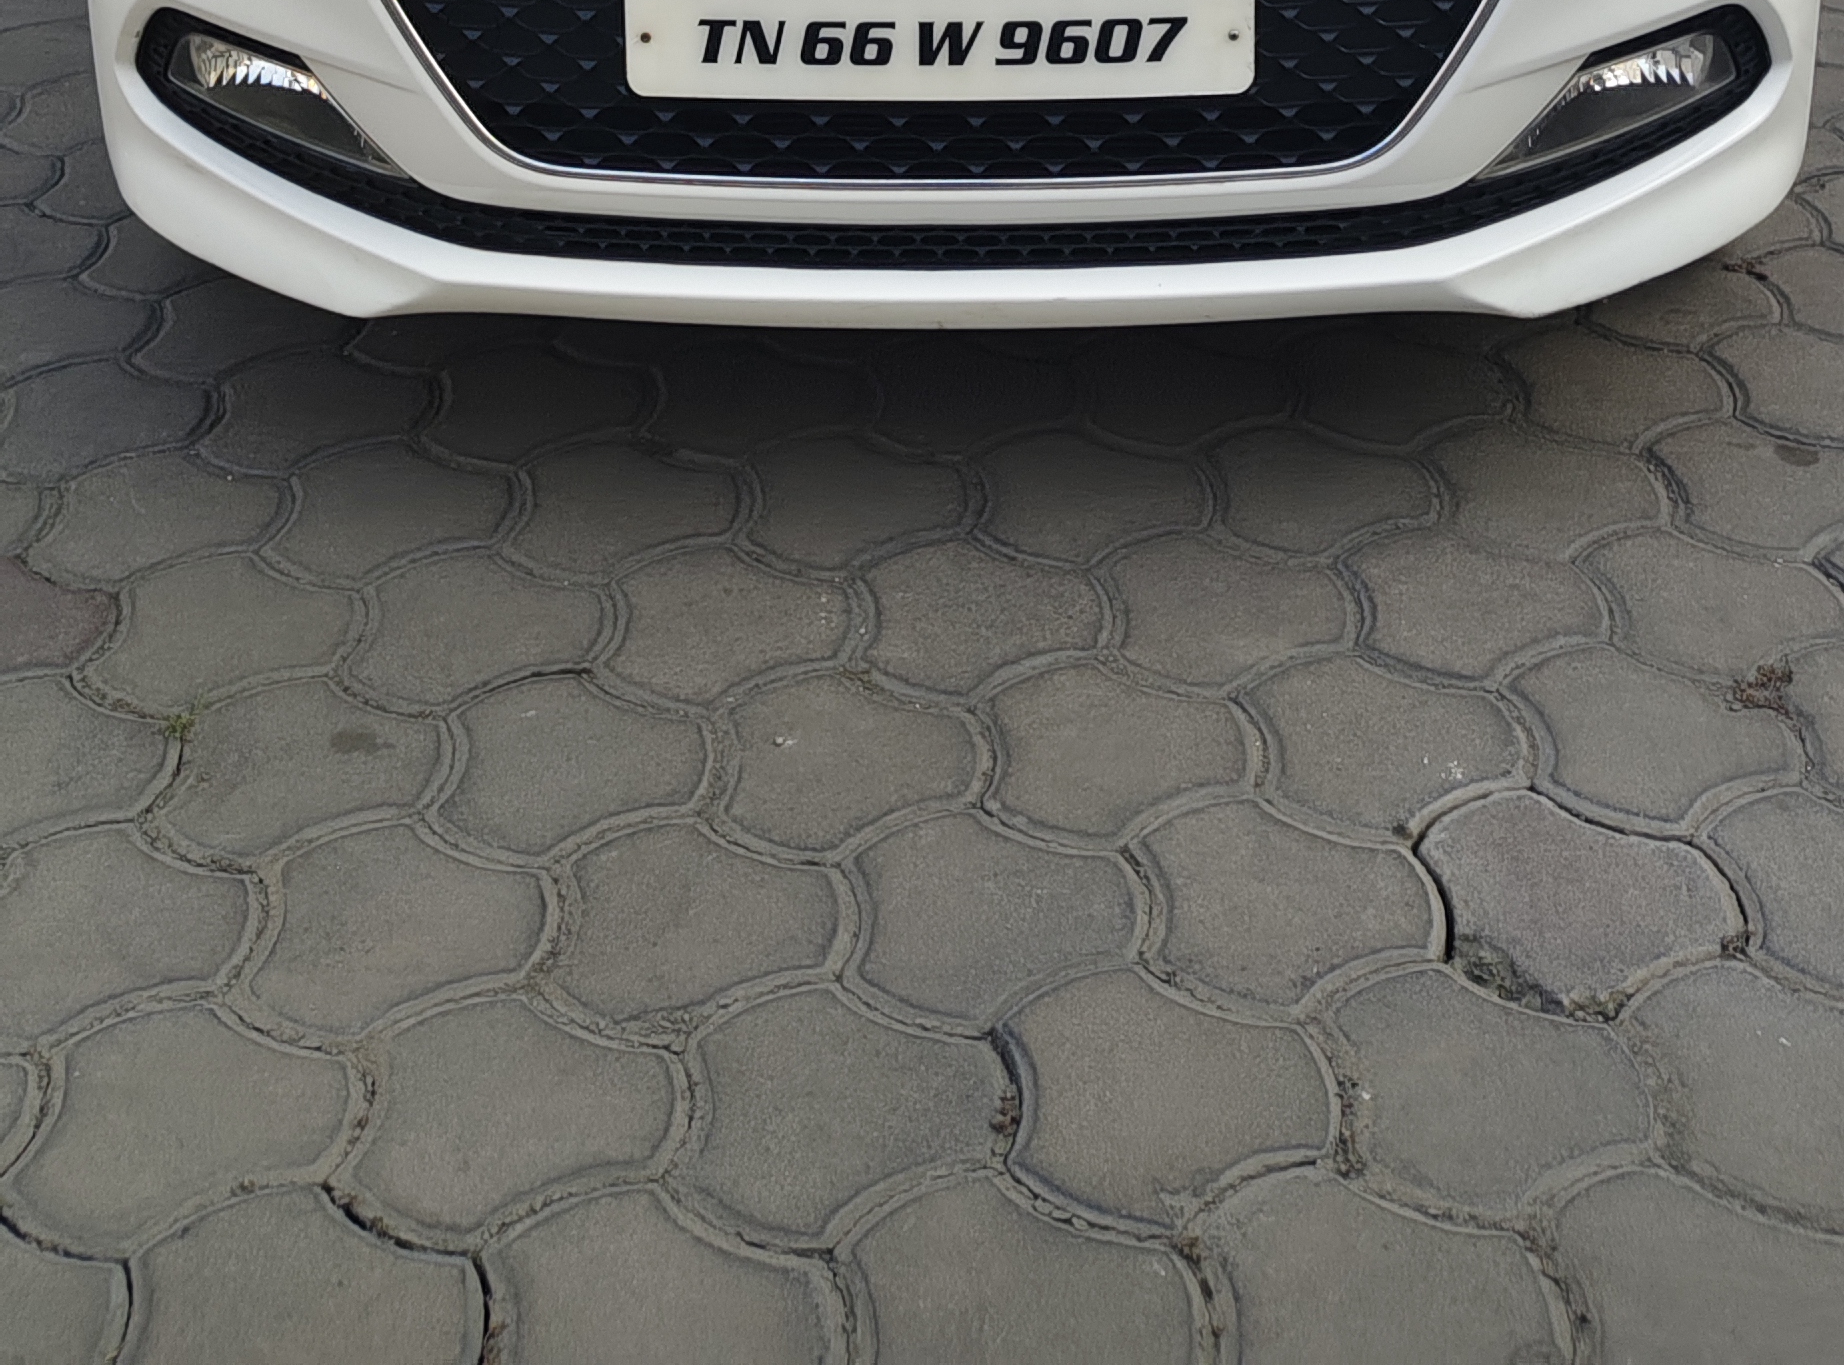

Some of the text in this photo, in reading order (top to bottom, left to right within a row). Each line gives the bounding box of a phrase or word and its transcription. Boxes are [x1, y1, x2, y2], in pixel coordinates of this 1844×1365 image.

[697, 15, 1190, 67] TN 66 W 9607
